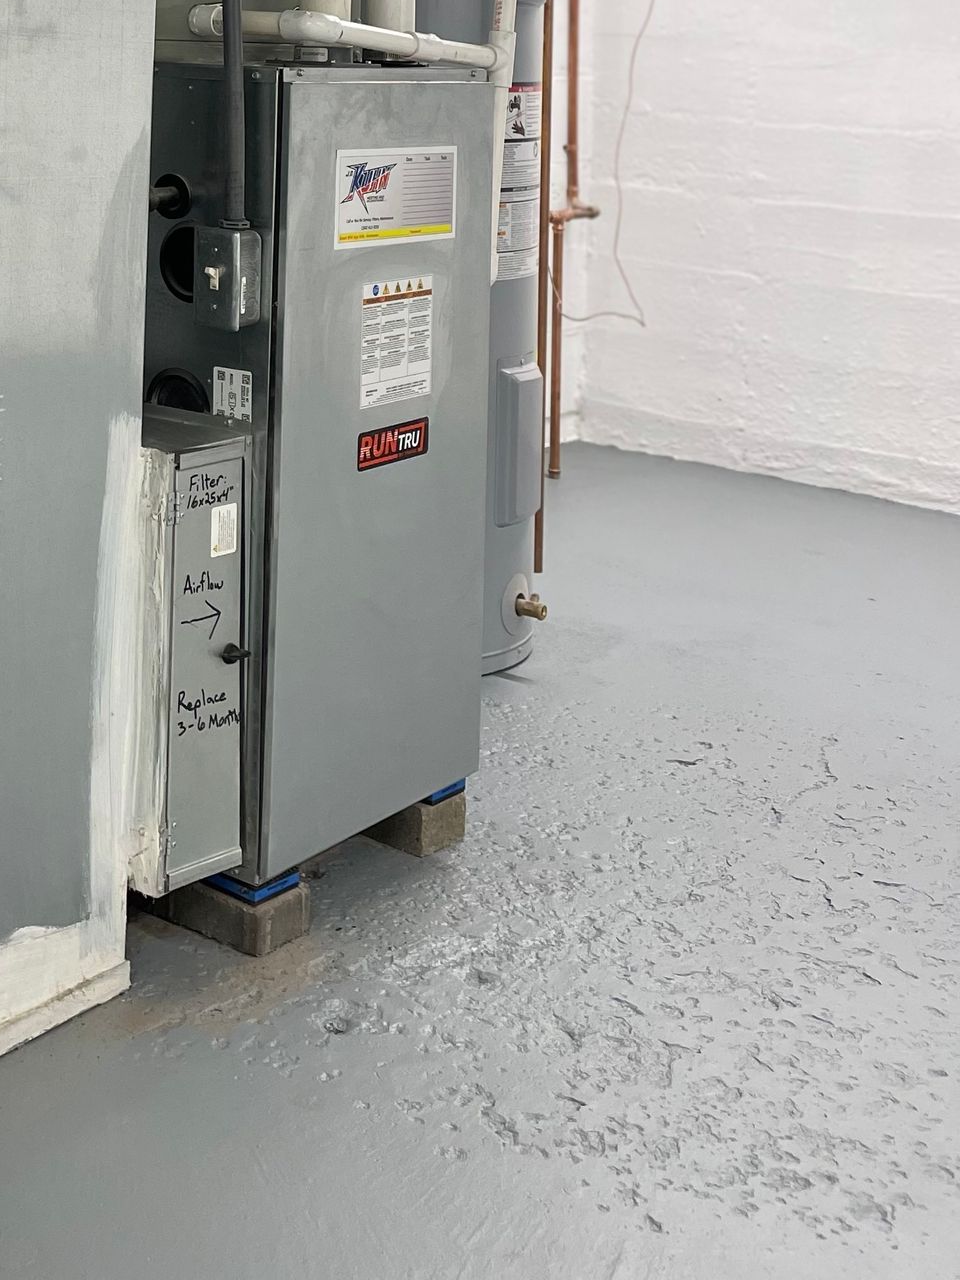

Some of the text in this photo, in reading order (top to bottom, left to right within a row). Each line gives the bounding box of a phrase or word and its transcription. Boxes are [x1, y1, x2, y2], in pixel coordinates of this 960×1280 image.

[189, 473, 227, 492] Filter:
[186, 485, 234, 509] 16x25x4"
[183, 571, 224, 595] Airflow
[177, 688, 227, 719] Replace
